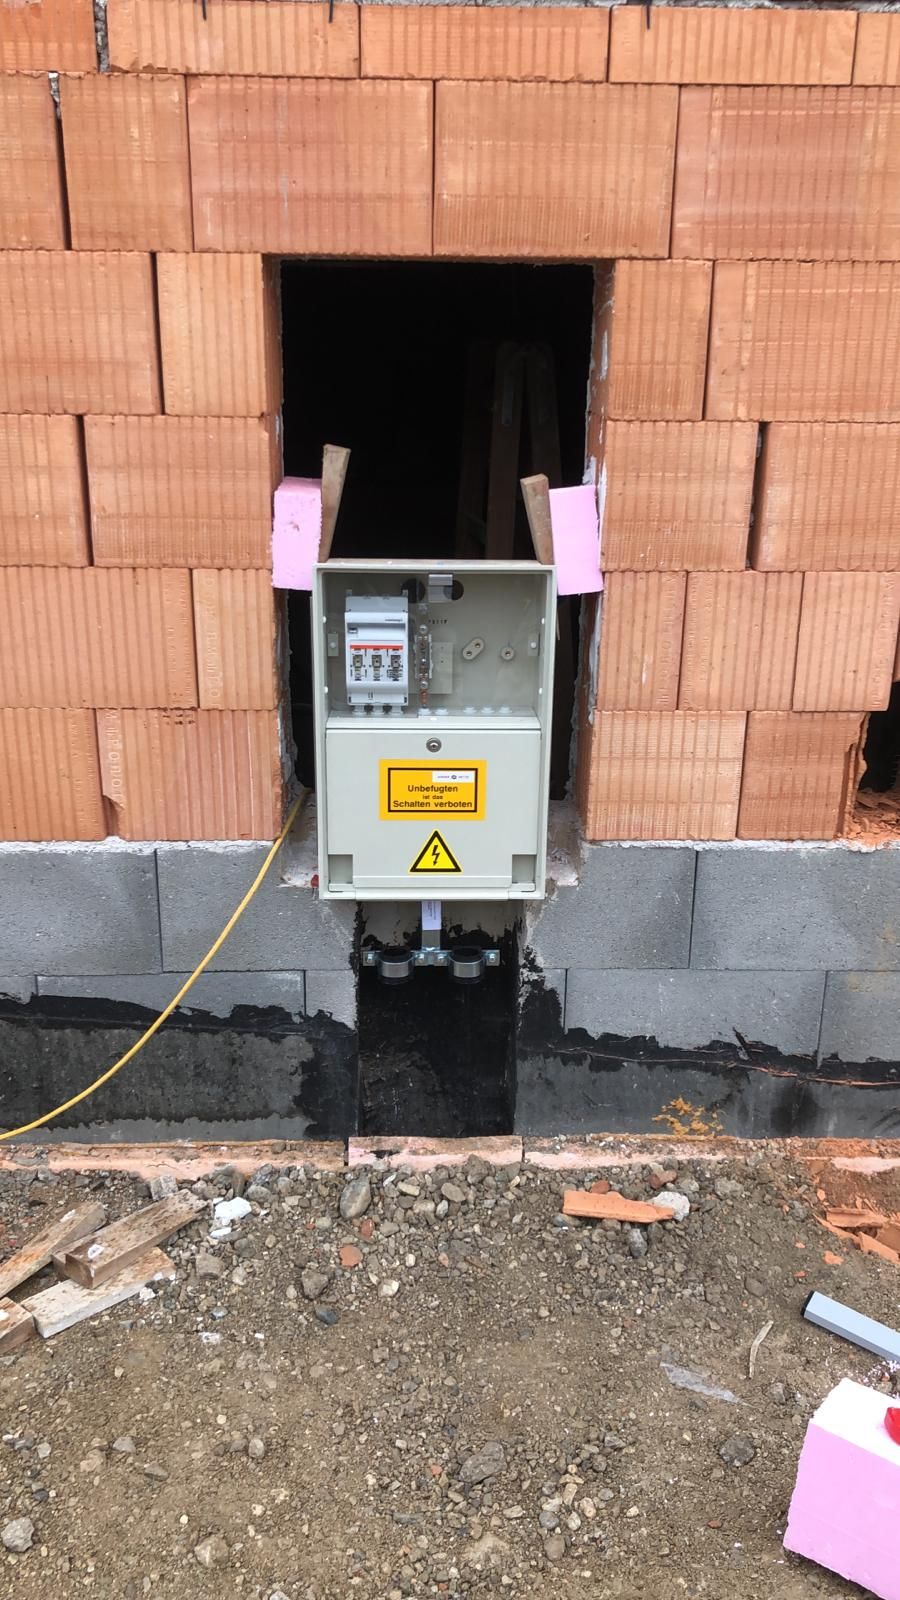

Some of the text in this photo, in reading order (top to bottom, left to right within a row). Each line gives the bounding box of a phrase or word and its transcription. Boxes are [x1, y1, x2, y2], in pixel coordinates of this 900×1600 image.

[407, 785, 458, 794] Unbefugten
[393, 800, 473, 808] Schalten verboten
